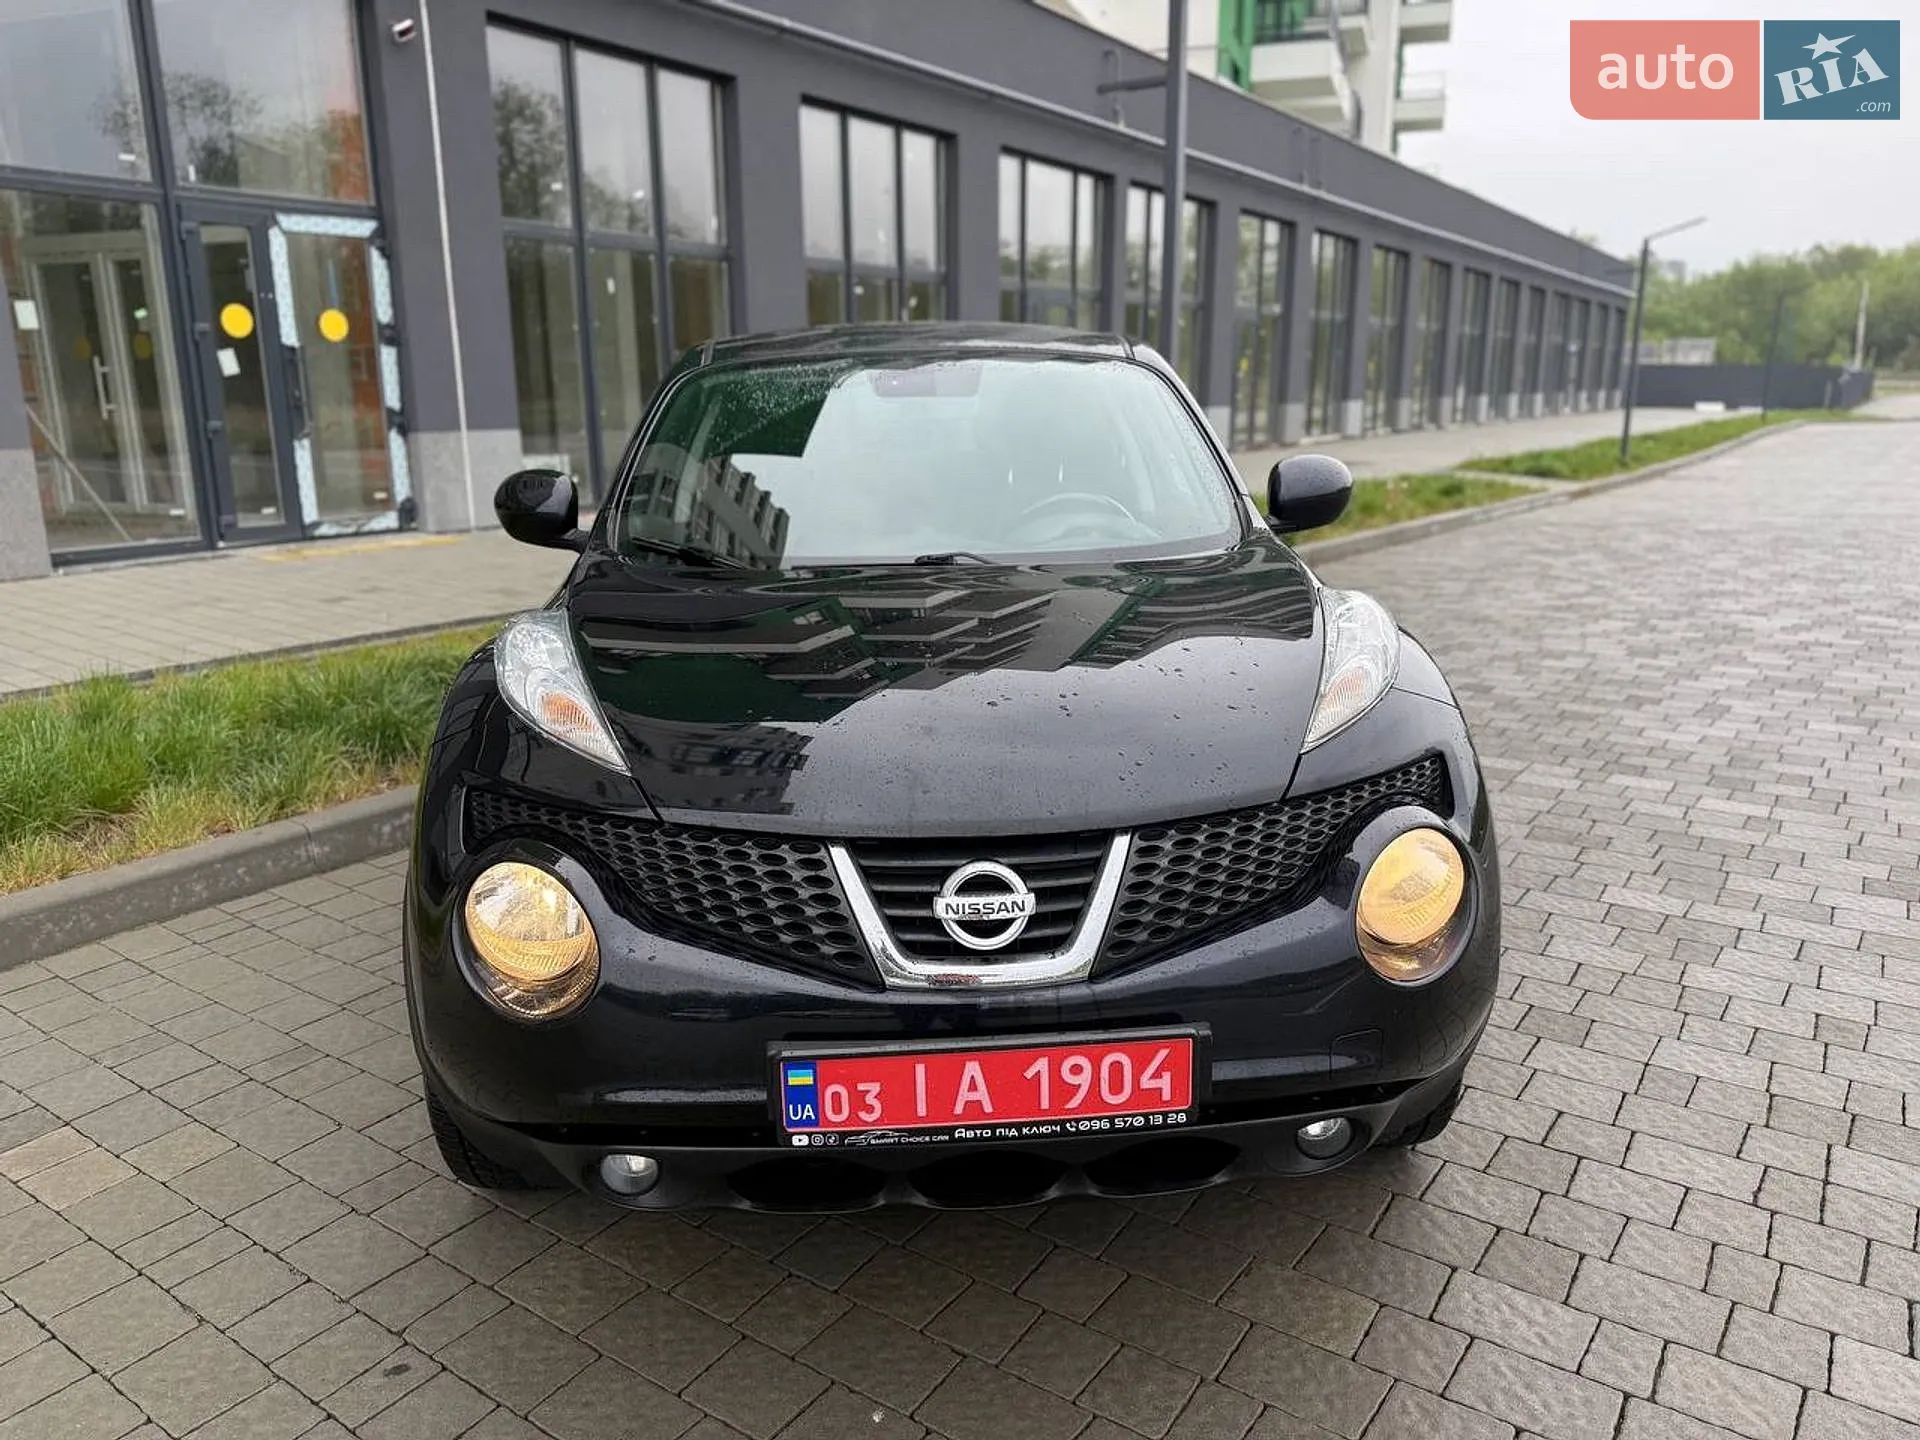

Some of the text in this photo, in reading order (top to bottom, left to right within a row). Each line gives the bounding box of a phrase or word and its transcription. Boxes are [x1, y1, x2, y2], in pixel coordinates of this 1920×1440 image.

[945, 899, 1025, 915] NISSAN
[824, 1082, 882, 1123] 03
[1023, 1047, 1172, 1110] 1904
[789, 1104, 816, 1120] UA
[1078, 1119, 1111, 1131] 096
[1114, 1116, 1145, 1128] 570
[1149, 1114, 1163, 1125] 13
[1167, 1112, 1187, 1124] 28
